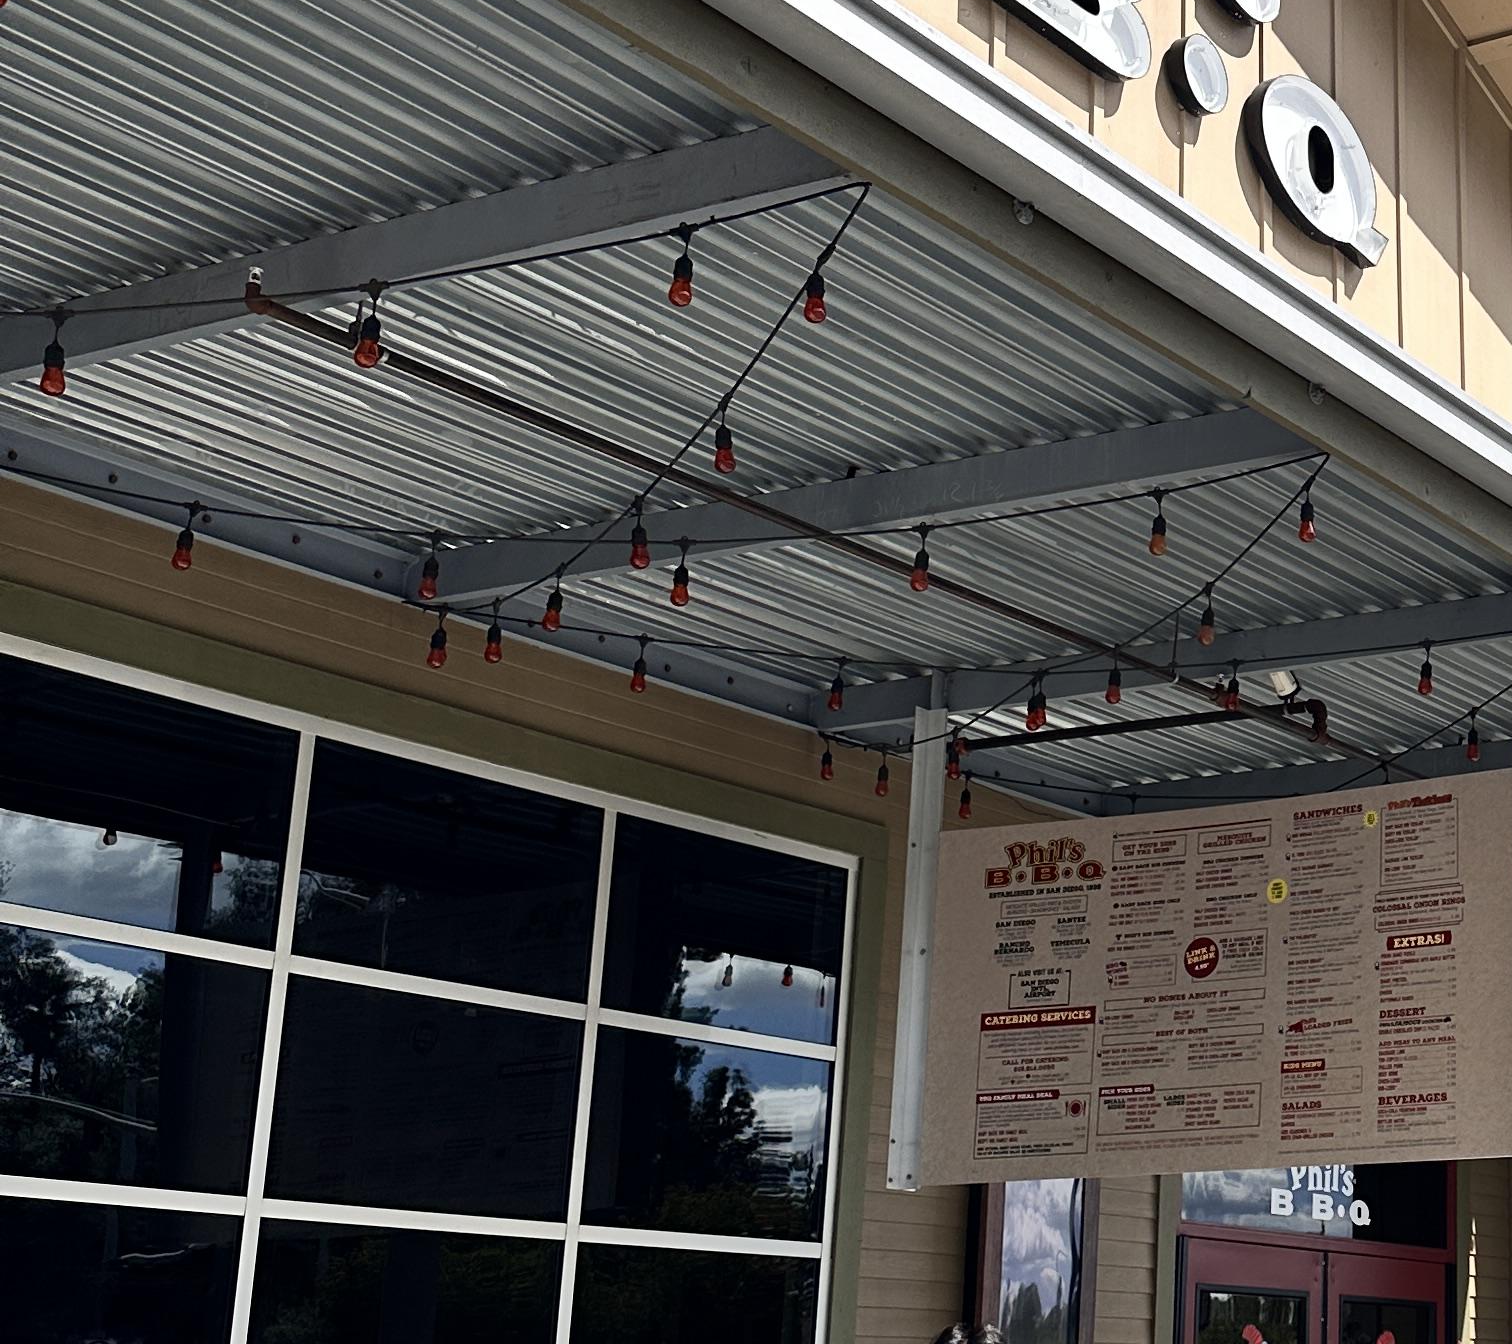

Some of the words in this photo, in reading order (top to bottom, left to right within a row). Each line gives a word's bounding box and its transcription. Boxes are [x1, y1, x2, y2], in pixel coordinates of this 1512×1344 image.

[1293, 804, 1363, 821] SANDWICHES
[1004, 837, 1086, 869] Phil's
[984, 1013, 1038, 1026] CATERING
[1040, 1010, 1091, 1022] SERVICES
[1379, 1006, 1426, 1019] DESSERT
[1281, 1101, 1322, 1111] SALADS
[1377, 1092, 1448, 1106] BEVERAGES
